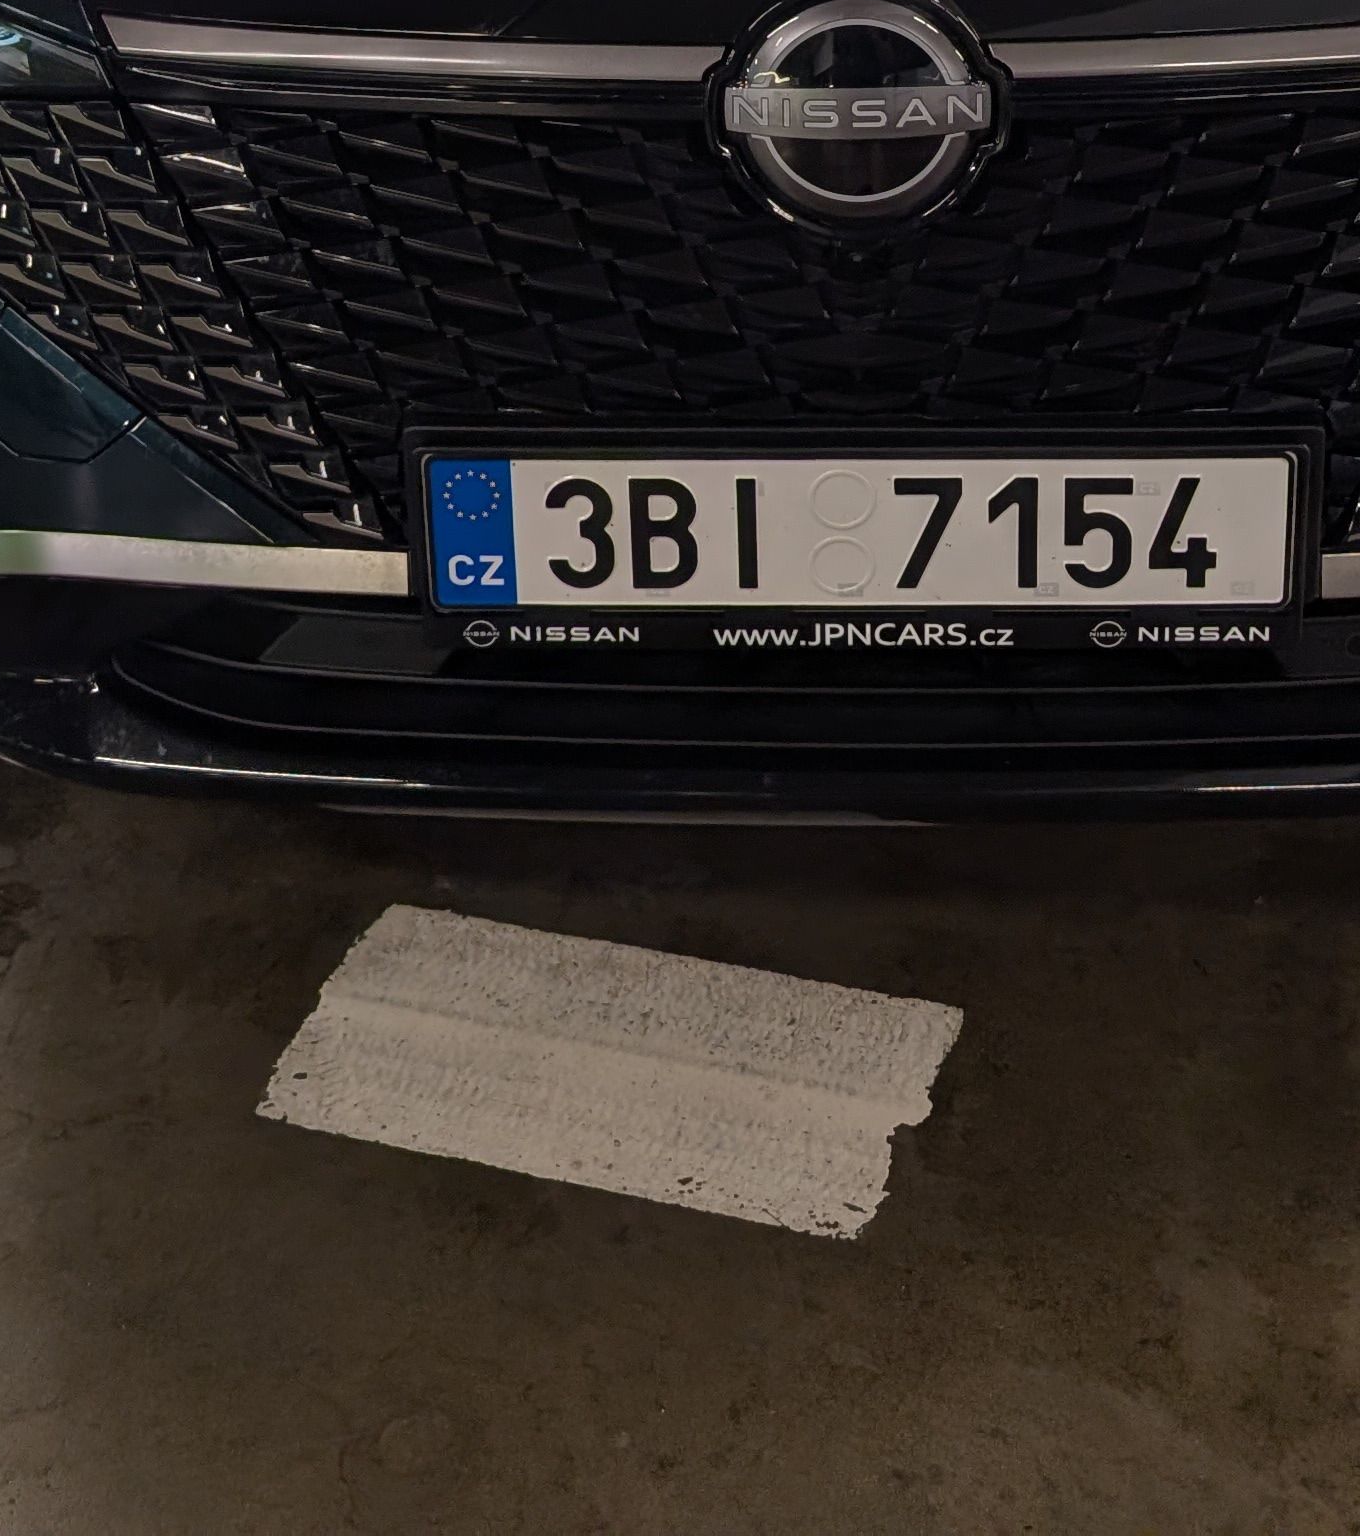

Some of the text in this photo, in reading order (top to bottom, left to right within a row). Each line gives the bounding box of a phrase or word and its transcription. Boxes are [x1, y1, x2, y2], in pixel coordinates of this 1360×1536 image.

[732, 93, 983, 128] NISSAN
[448, 477, 1217, 589] CZ 3BI 7154
[510, 625, 640, 643] NISSAN
[712, 622, 1014, 647] www.JPNCARS.cz
[1137, 626, 1271, 642] NISSAN
